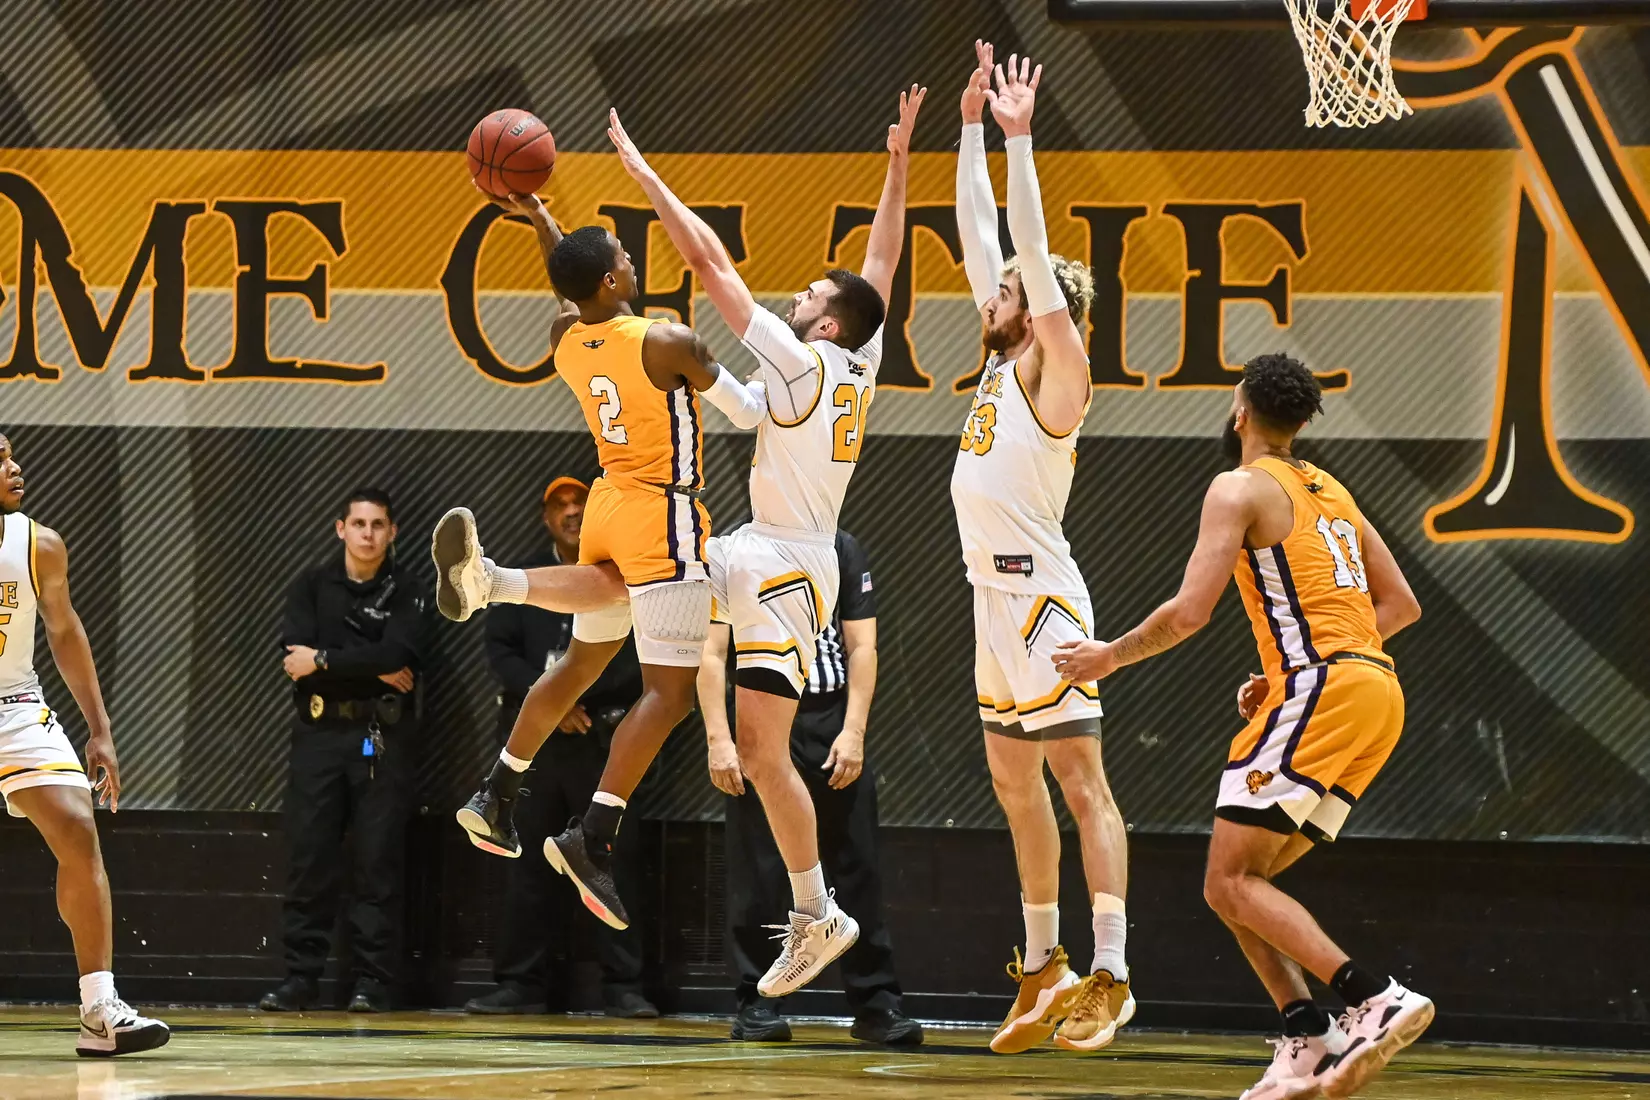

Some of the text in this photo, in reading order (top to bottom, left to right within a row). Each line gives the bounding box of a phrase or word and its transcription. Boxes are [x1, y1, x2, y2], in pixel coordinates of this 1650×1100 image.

[0, 168, 388, 385] ME
[588, 375, 628, 445] 2
[1316, 514, 1368, 593] 13
